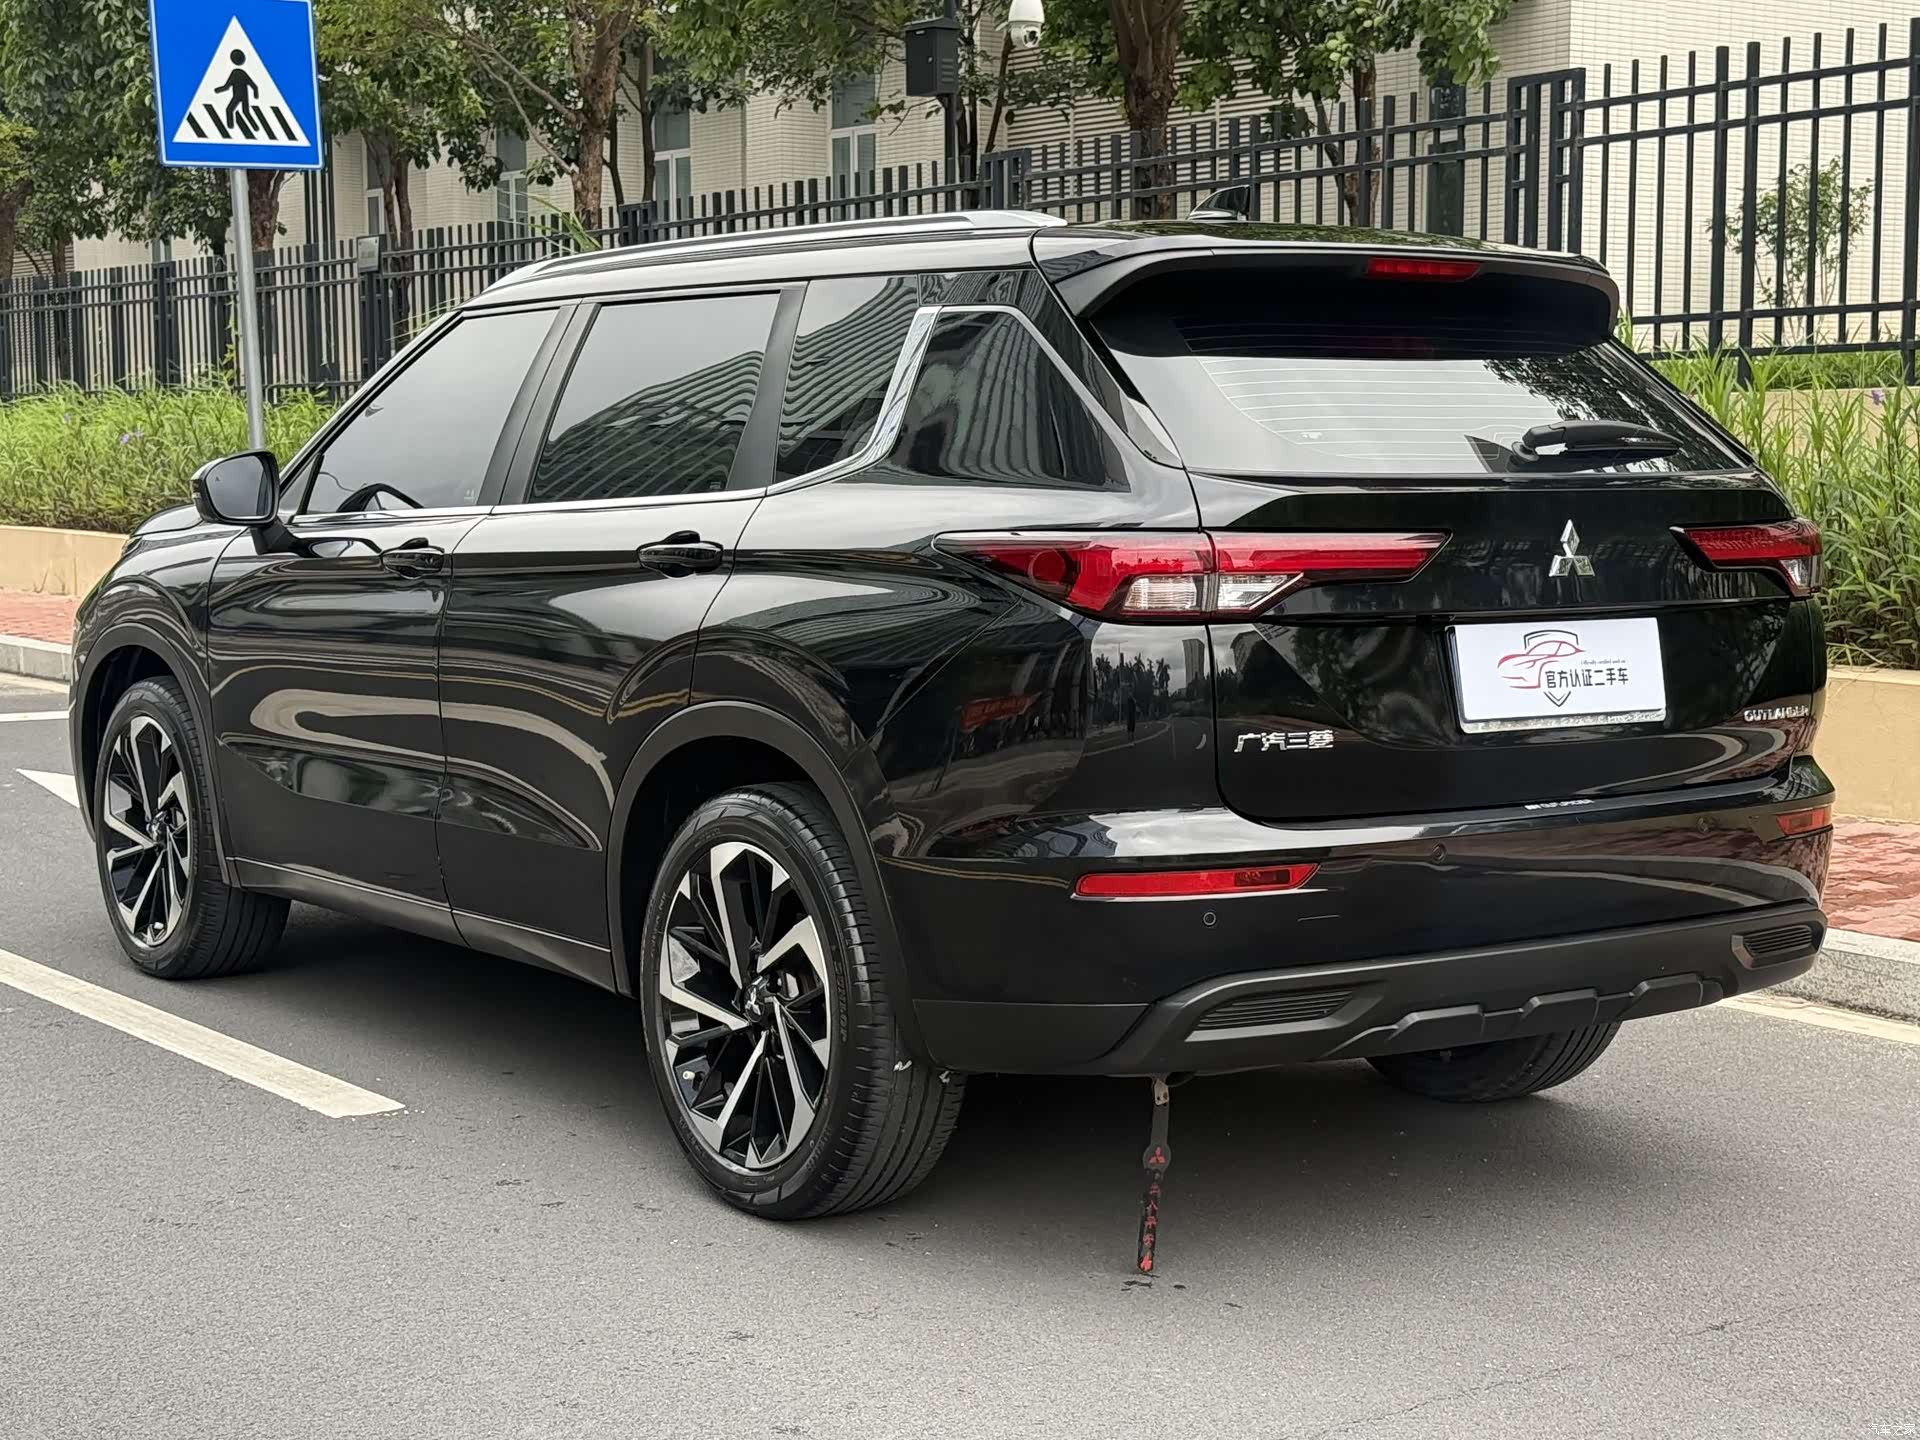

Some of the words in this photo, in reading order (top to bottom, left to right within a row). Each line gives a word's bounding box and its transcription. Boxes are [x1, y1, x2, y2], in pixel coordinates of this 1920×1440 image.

[1545, 668, 1629, 689] 官方认证二手车
[1743, 705, 1809, 722] OUTLANDER
[1234, 730, 1334, 753] 广汽三菱
